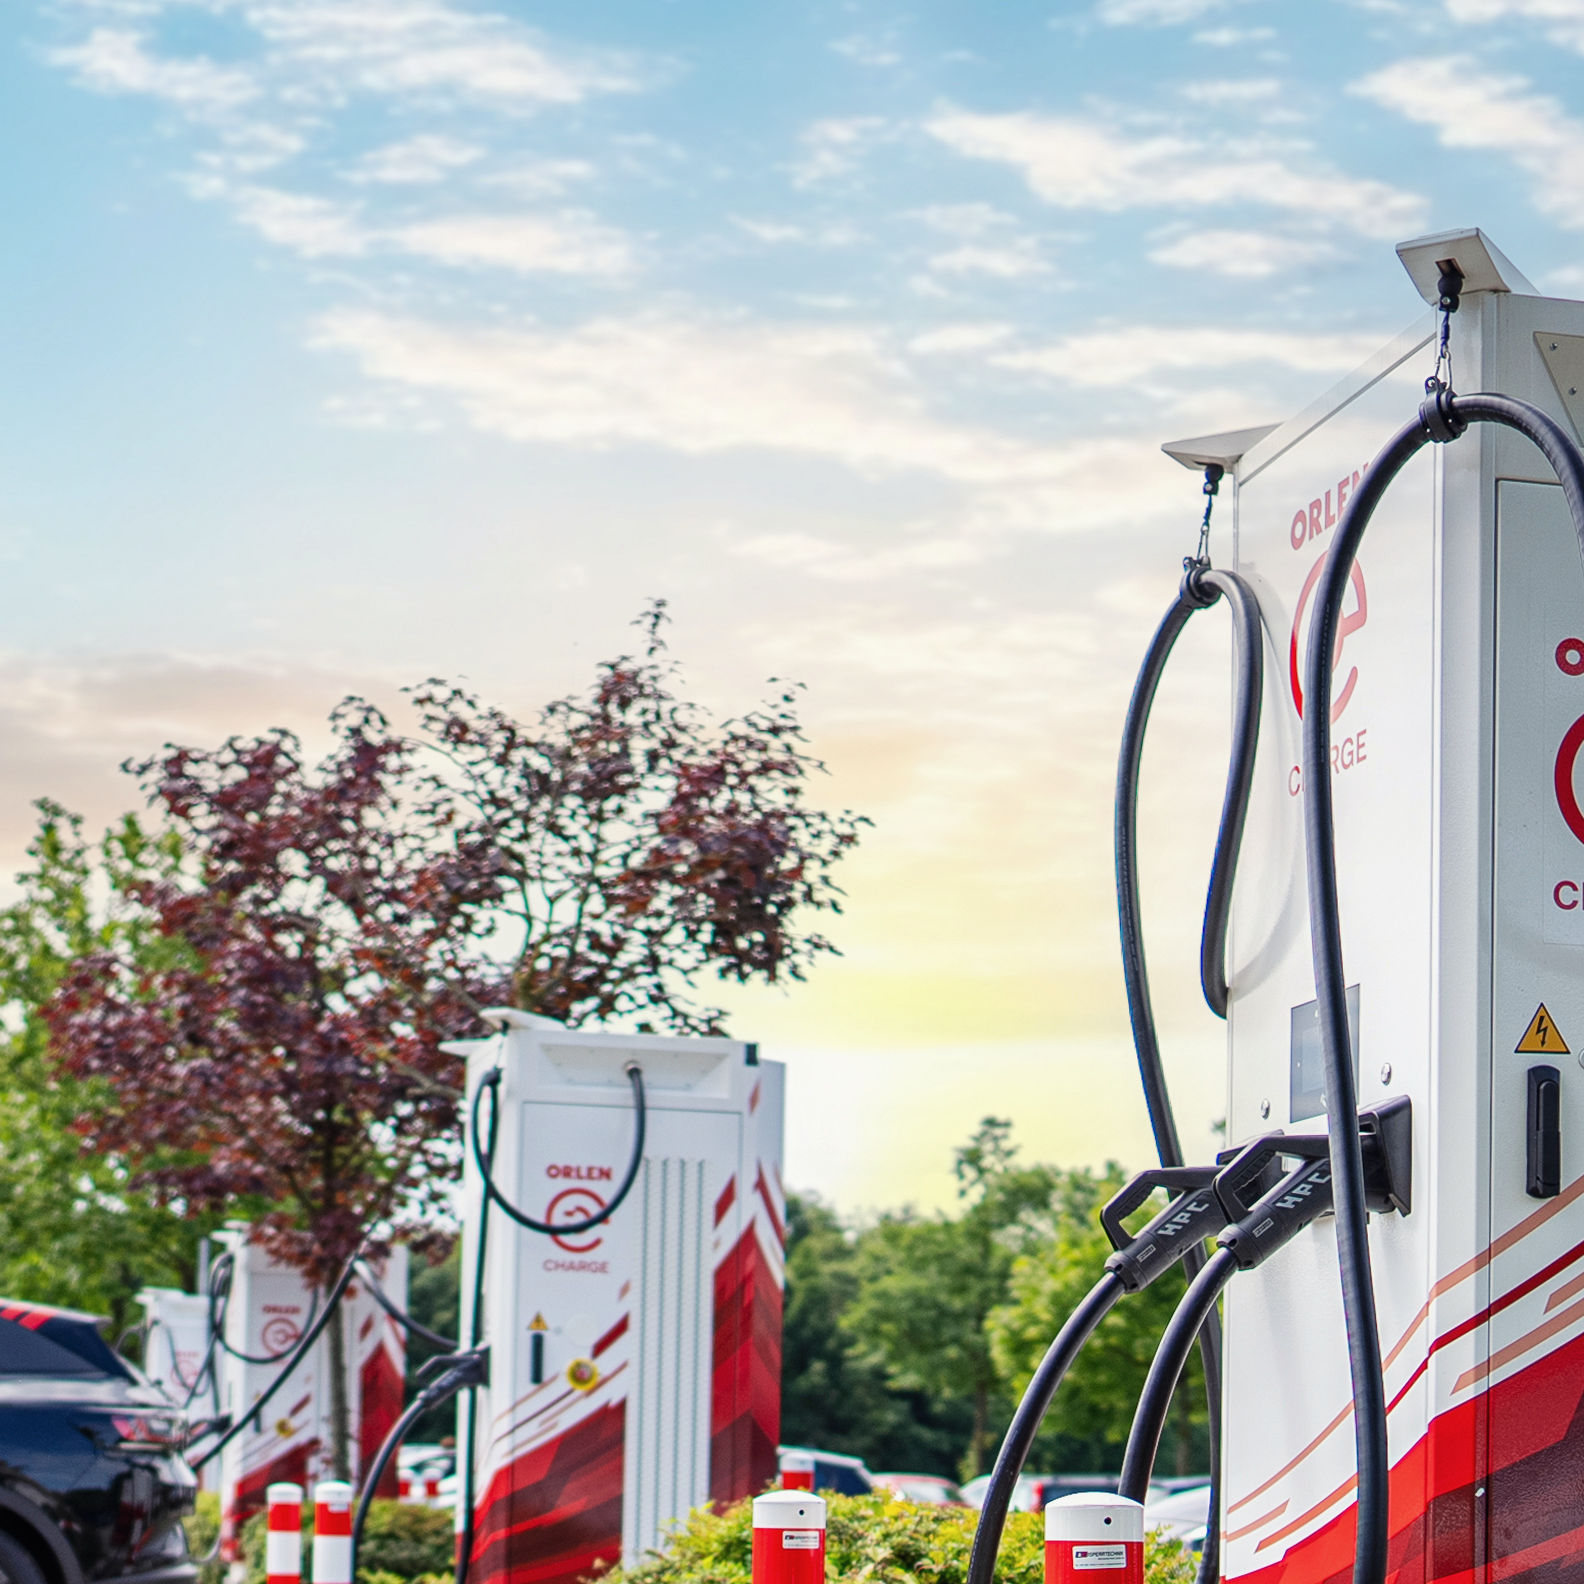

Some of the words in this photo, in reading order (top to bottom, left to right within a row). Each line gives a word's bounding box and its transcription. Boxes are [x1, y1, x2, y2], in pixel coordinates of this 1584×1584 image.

[1288, 729, 1368, 797] CRGE
[546, 1164, 613, 1181] ORLEN
[1275, 1172, 1332, 1209] HPC
[1157, 1201, 1210, 1237] HPC
[543, 1259, 610, 1274] CHARGE
